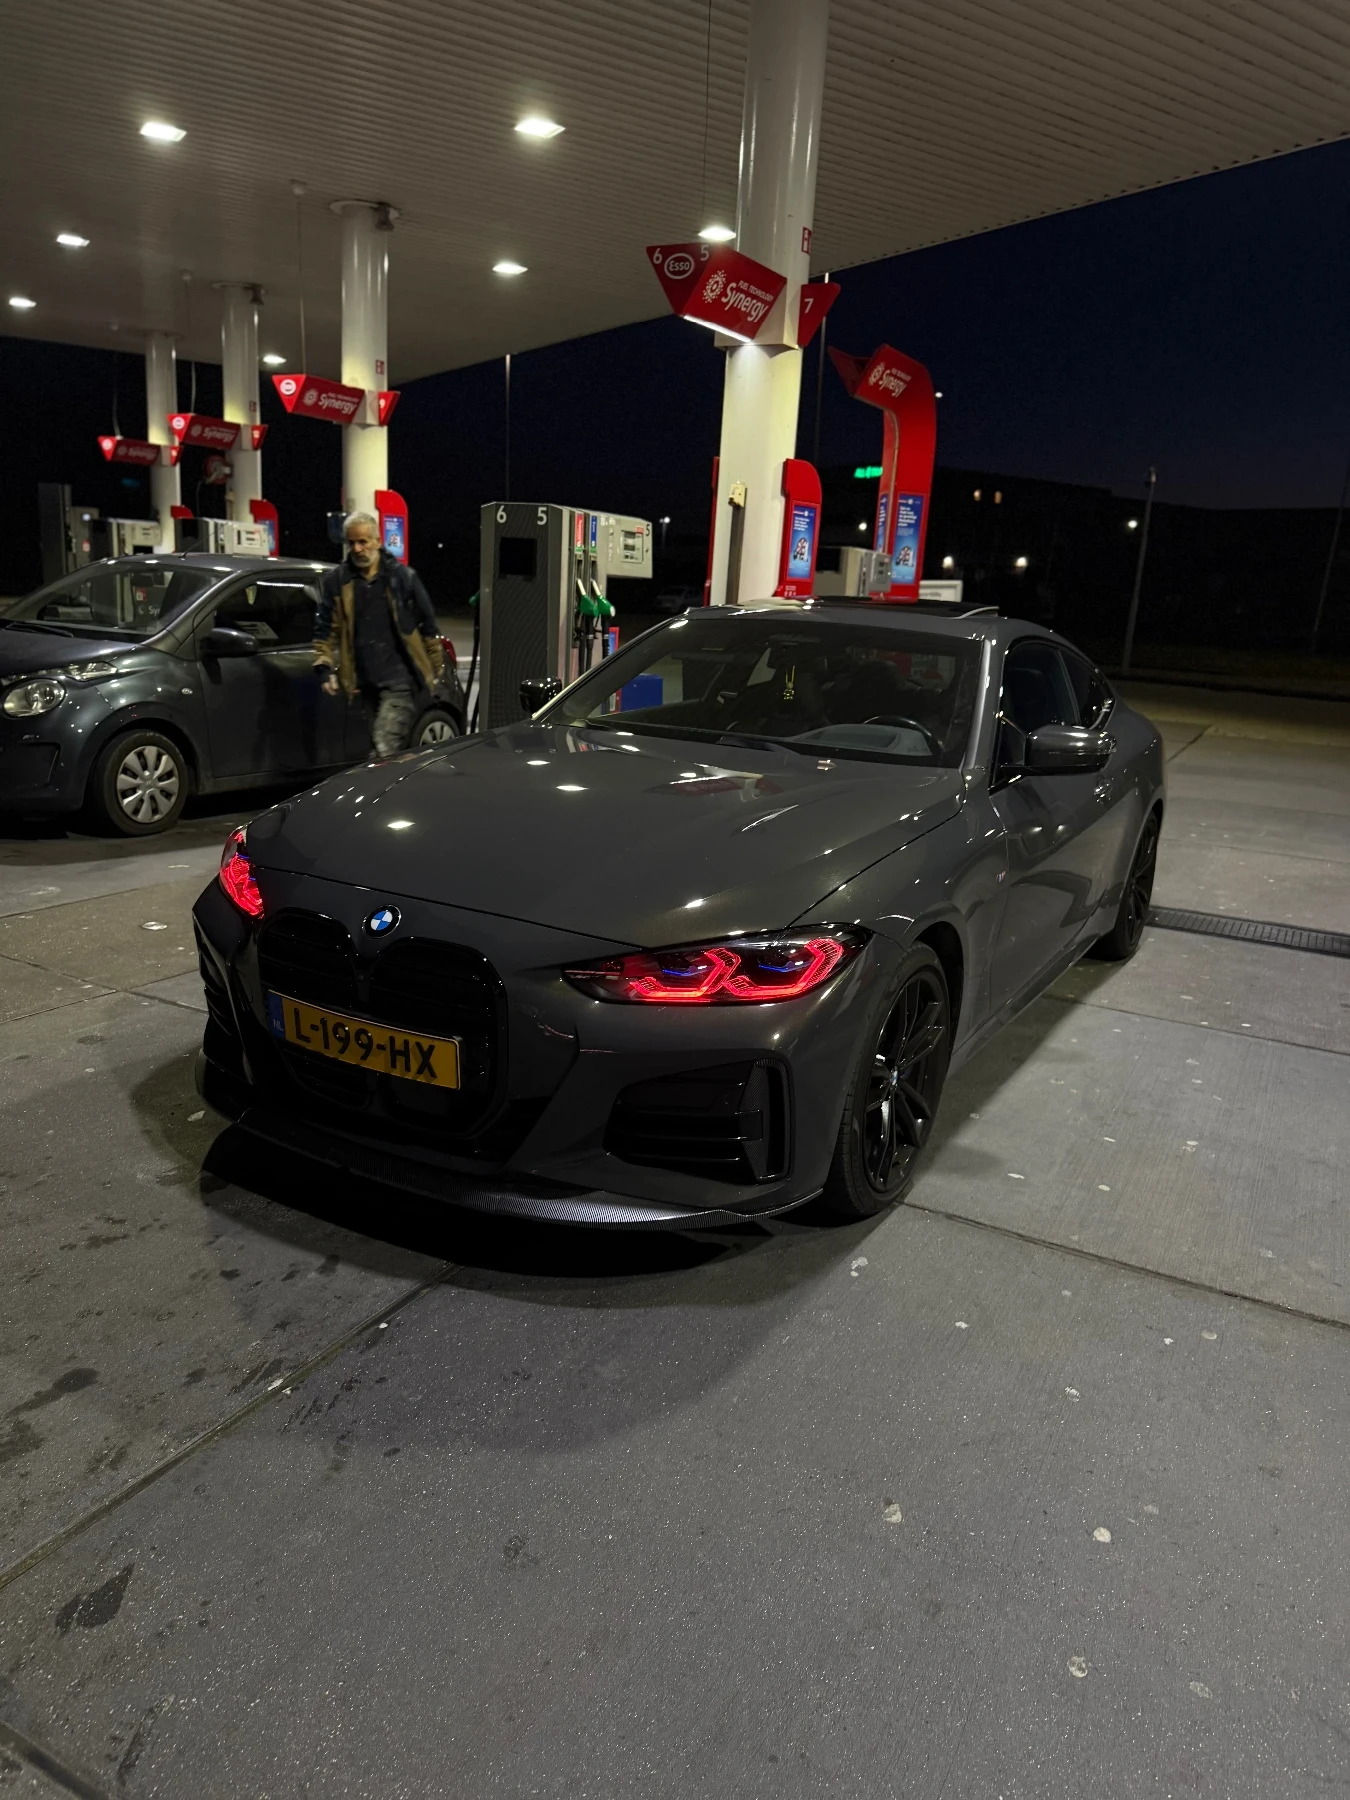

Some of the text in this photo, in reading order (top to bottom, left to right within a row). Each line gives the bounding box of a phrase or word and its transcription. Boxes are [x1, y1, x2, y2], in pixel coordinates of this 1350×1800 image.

[653, 248, 662, 264] 6
[700, 244, 709, 261] 5
[669, 260, 690, 271] Esso
[738, 280, 749, 290] FUEL
[721, 282, 769, 322] Synergy
[804, 298, 814, 314] 7
[878, 369, 907, 398] Synergy
[318, 393, 357, 415] Synergy
[496, 505, 507, 523] 6
[537, 506, 547, 526] 5
[645, 523, 651, 537] 5
[293, 1007, 438, 1079] L-199-HX
